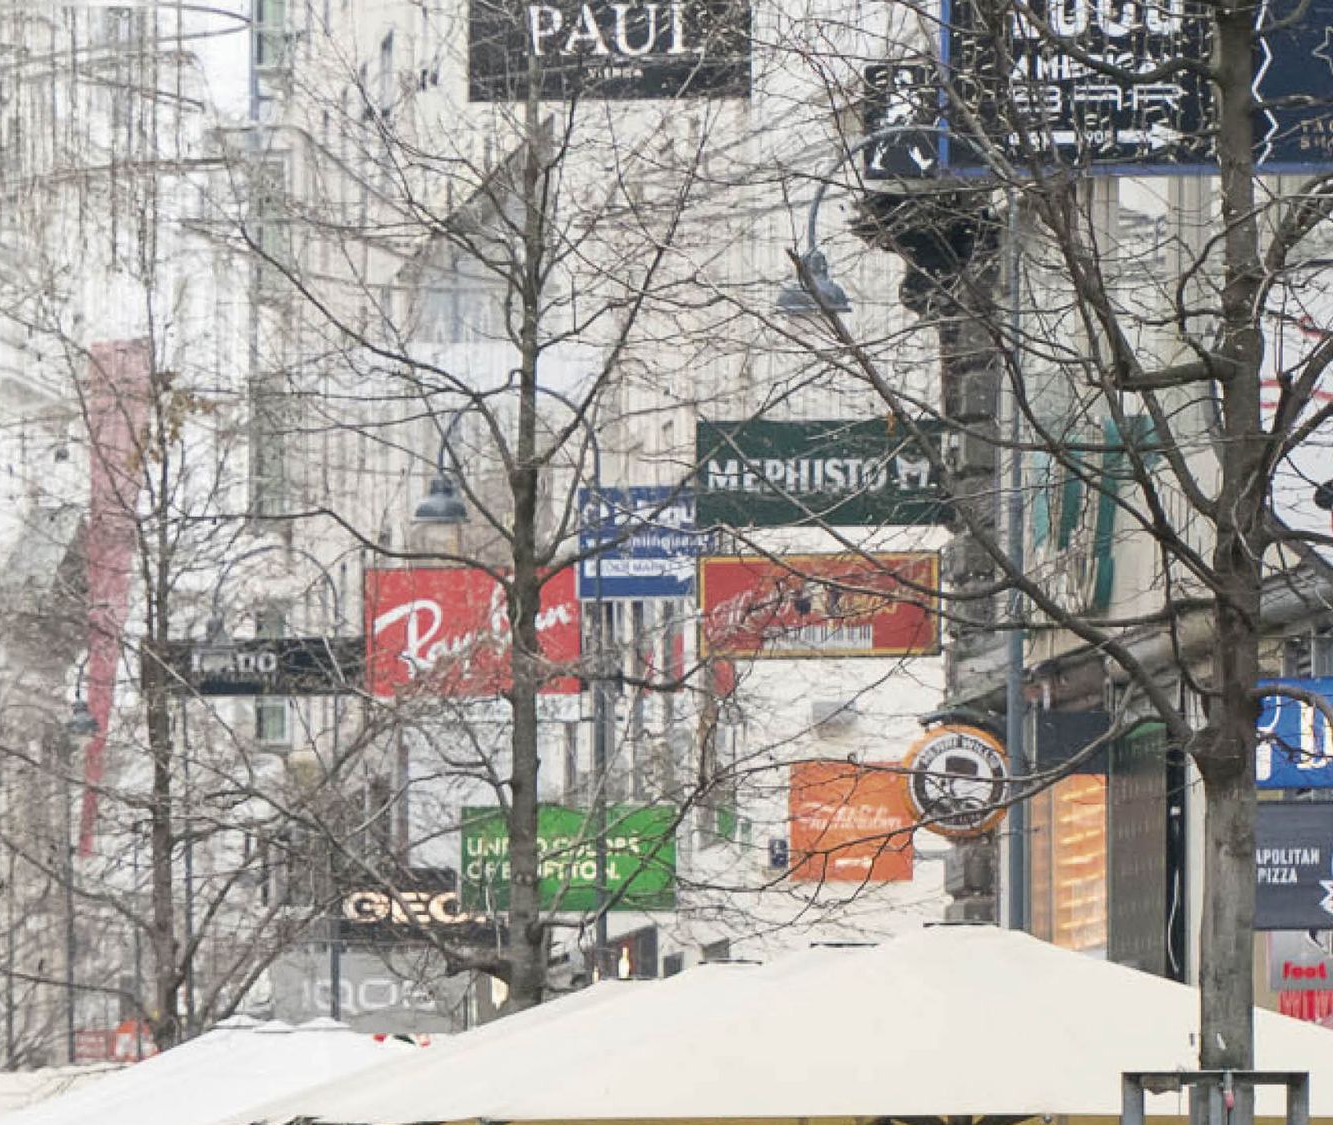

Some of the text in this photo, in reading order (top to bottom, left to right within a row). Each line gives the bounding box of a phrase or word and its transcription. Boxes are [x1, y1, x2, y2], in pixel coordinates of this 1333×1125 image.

[525, 3, 705, 56] PAUL
[707, 458, 886, 492] MEPHISTO
[1257, 868, 1299, 884] PIZZA
[342, 891, 488, 924] GEO
